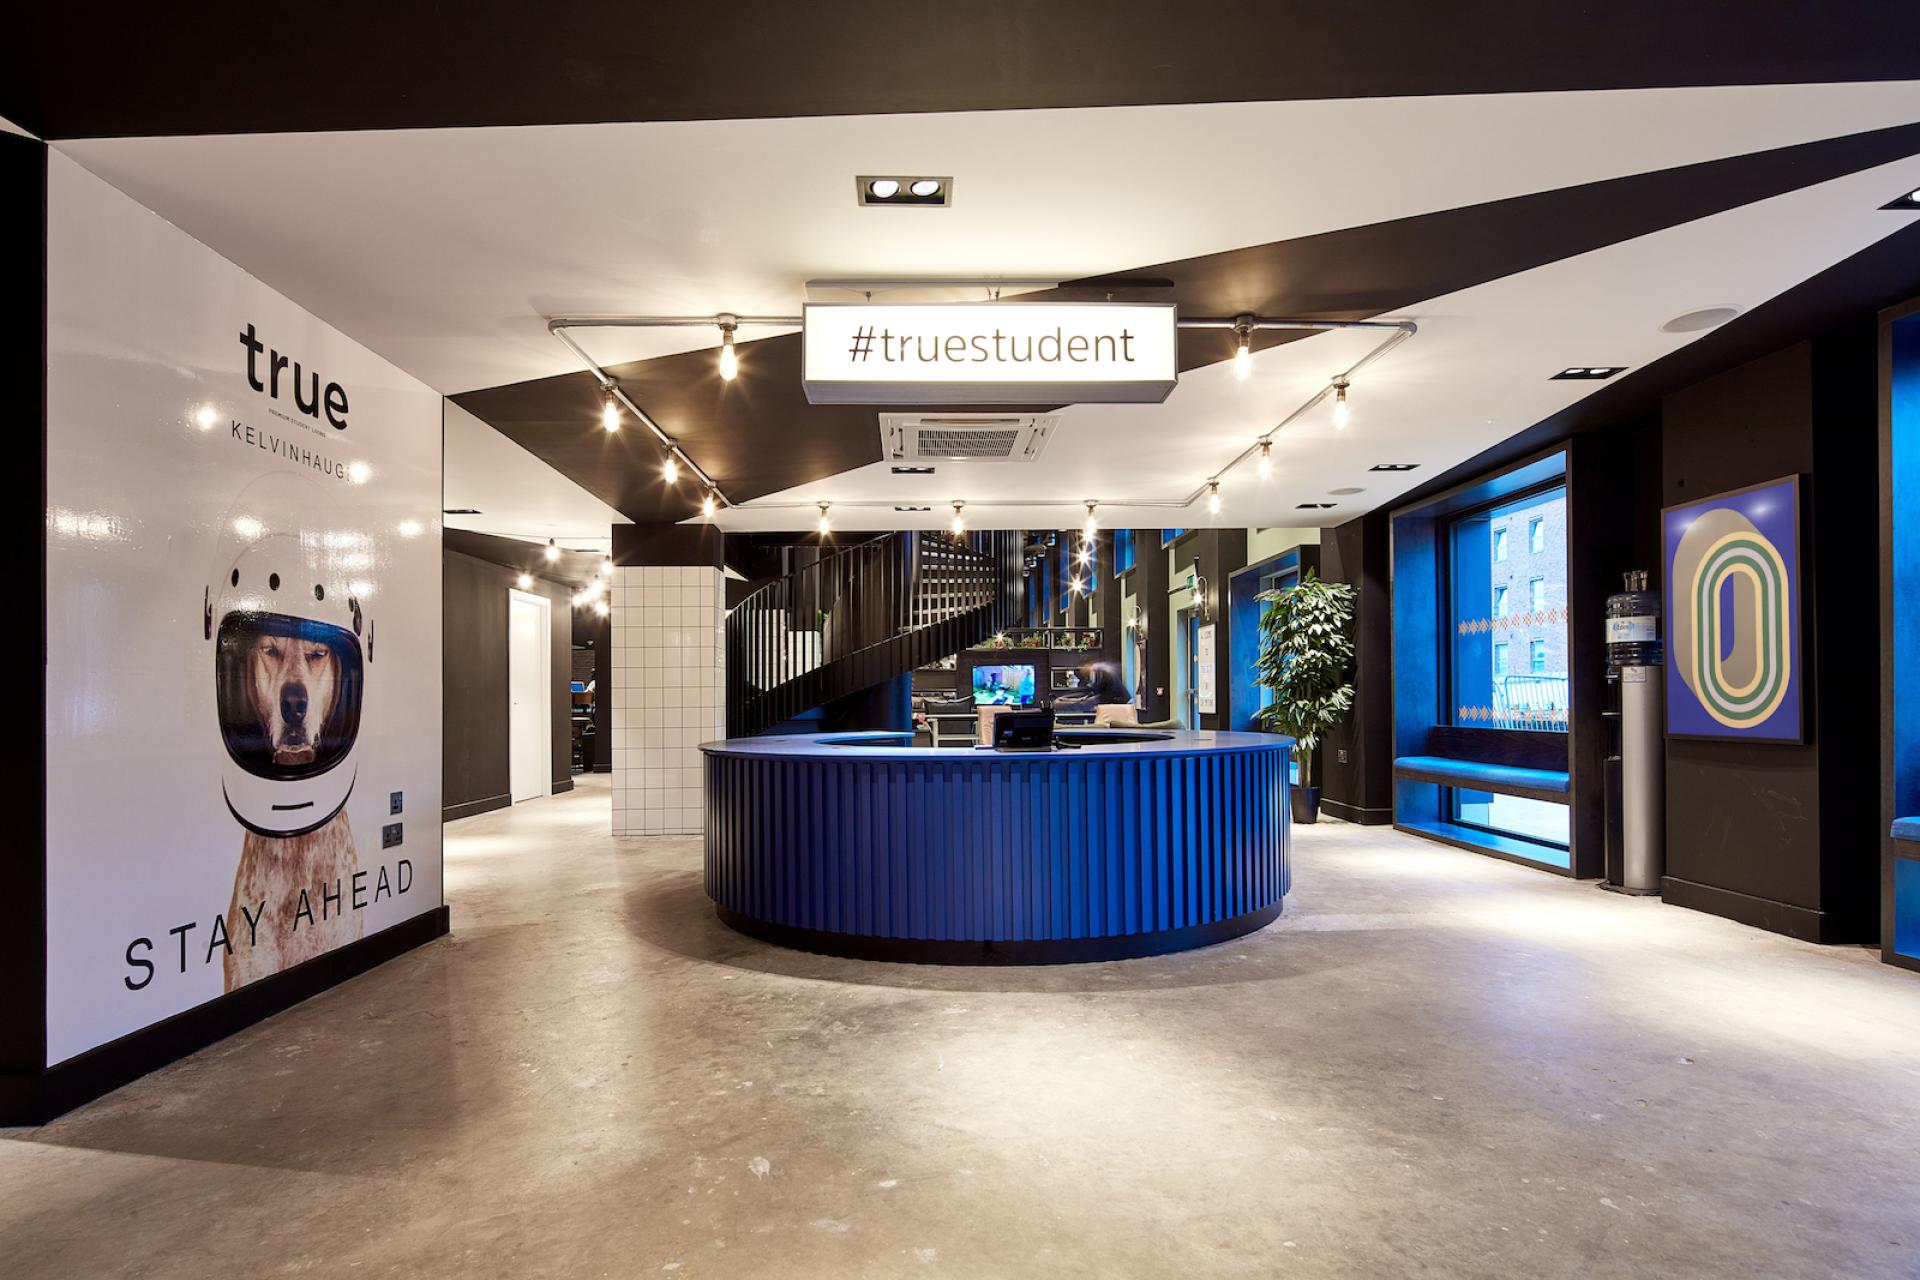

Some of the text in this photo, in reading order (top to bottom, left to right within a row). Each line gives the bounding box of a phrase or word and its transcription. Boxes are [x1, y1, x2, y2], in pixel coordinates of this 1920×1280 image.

[239, 323, 349, 430] true
[849, 326, 1135, 363] #truestudent
[124, 859, 413, 991] STAY AHEAD
